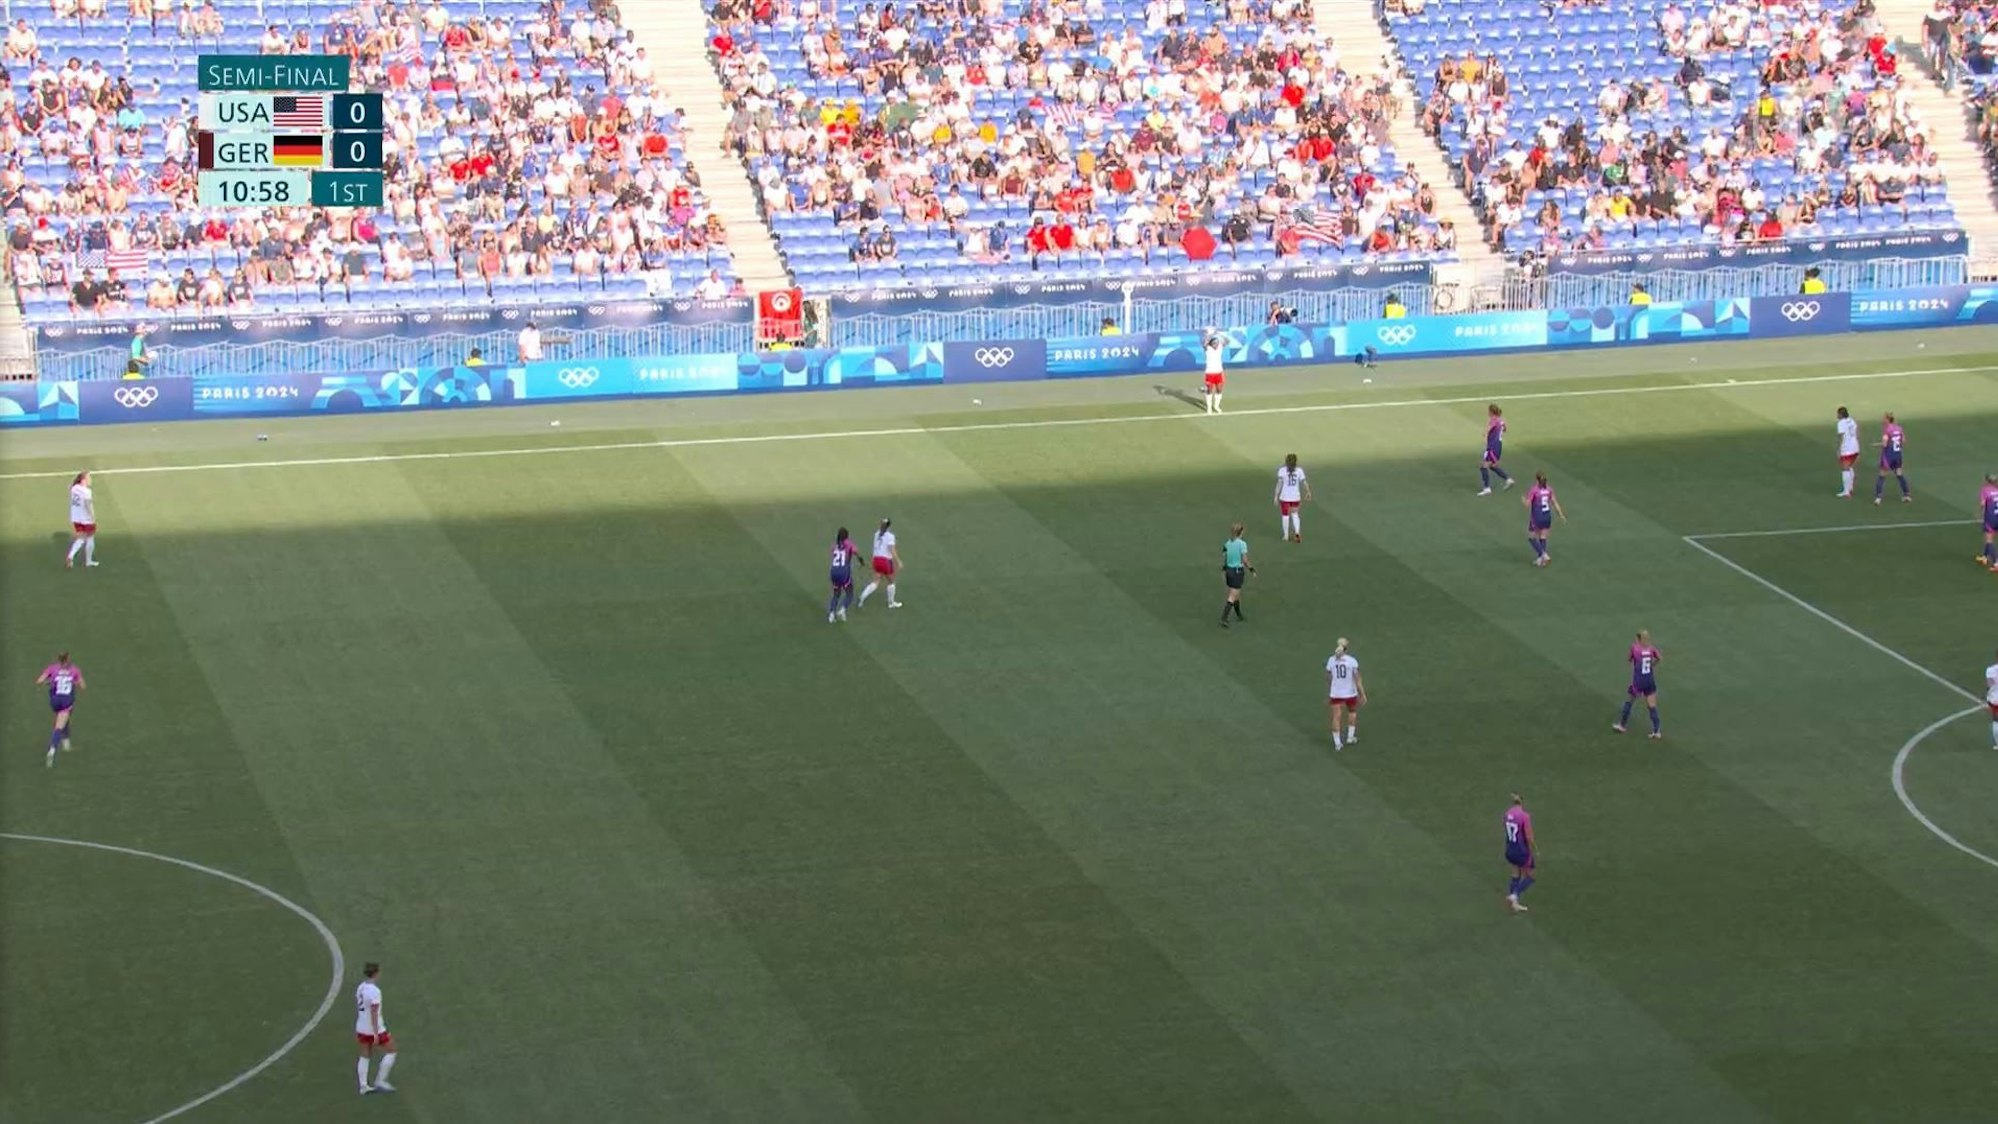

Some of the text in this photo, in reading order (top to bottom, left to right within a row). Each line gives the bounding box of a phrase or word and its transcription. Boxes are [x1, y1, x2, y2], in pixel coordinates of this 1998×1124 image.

[1859, 298, 1949, 313] PARIS 2024
[1455, 324, 1498, 337] PARIS
[1054, 346, 1140, 361] PARIS 2024
[202, 386, 299, 399] PARIS 2024
[1541, 495, 1551, 512] 5
[832, 548, 847, 567] 21
[1335, 664, 1347, 679] 10
[1505, 821, 1519, 843] 17
